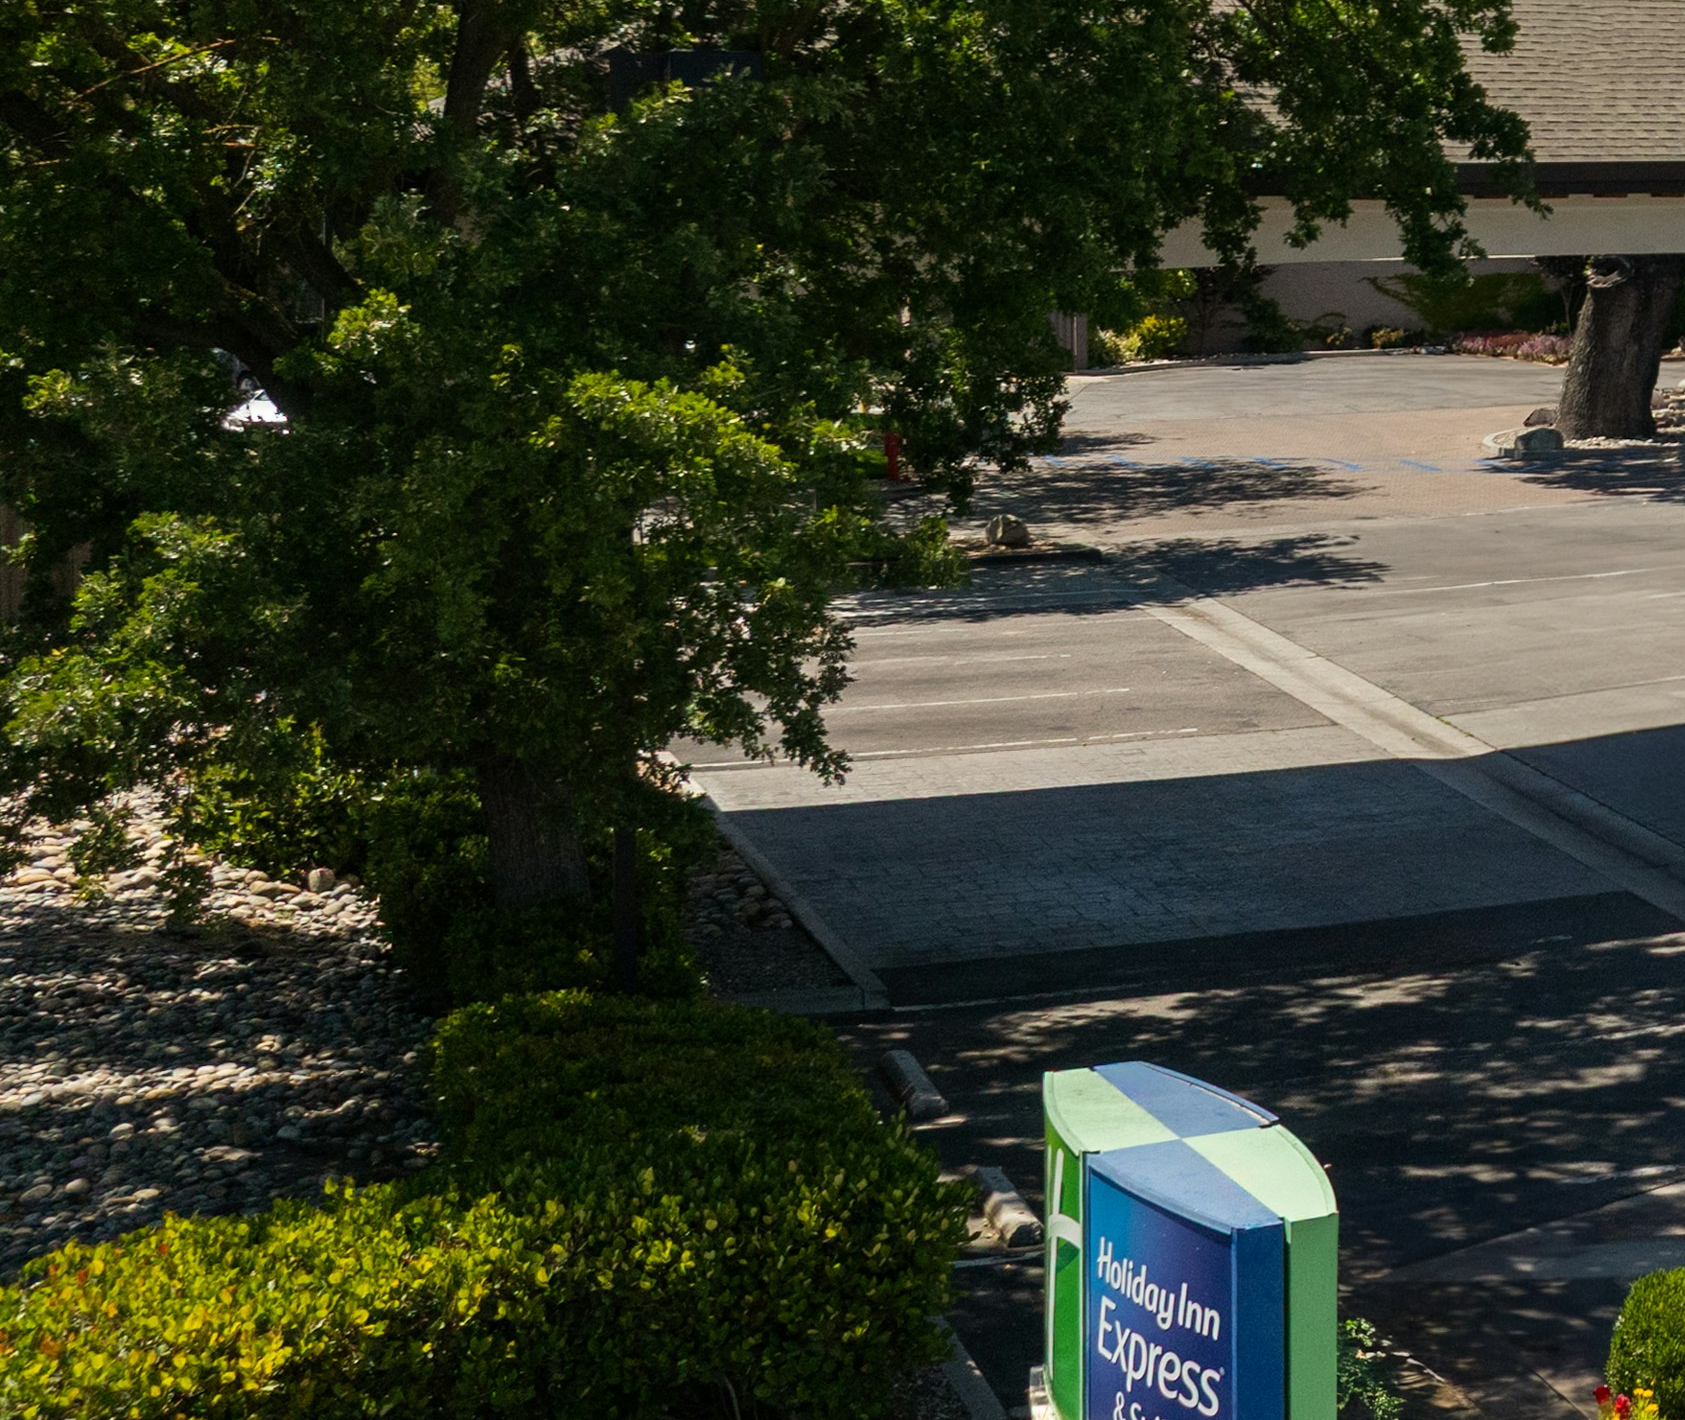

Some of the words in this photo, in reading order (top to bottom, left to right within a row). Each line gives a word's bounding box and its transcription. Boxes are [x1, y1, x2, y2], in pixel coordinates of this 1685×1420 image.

[1097, 1236, 1176, 1330] Holiday
[1178, 1282, 1221, 1341] Inn
[1097, 1295, 1221, 1417] Express
